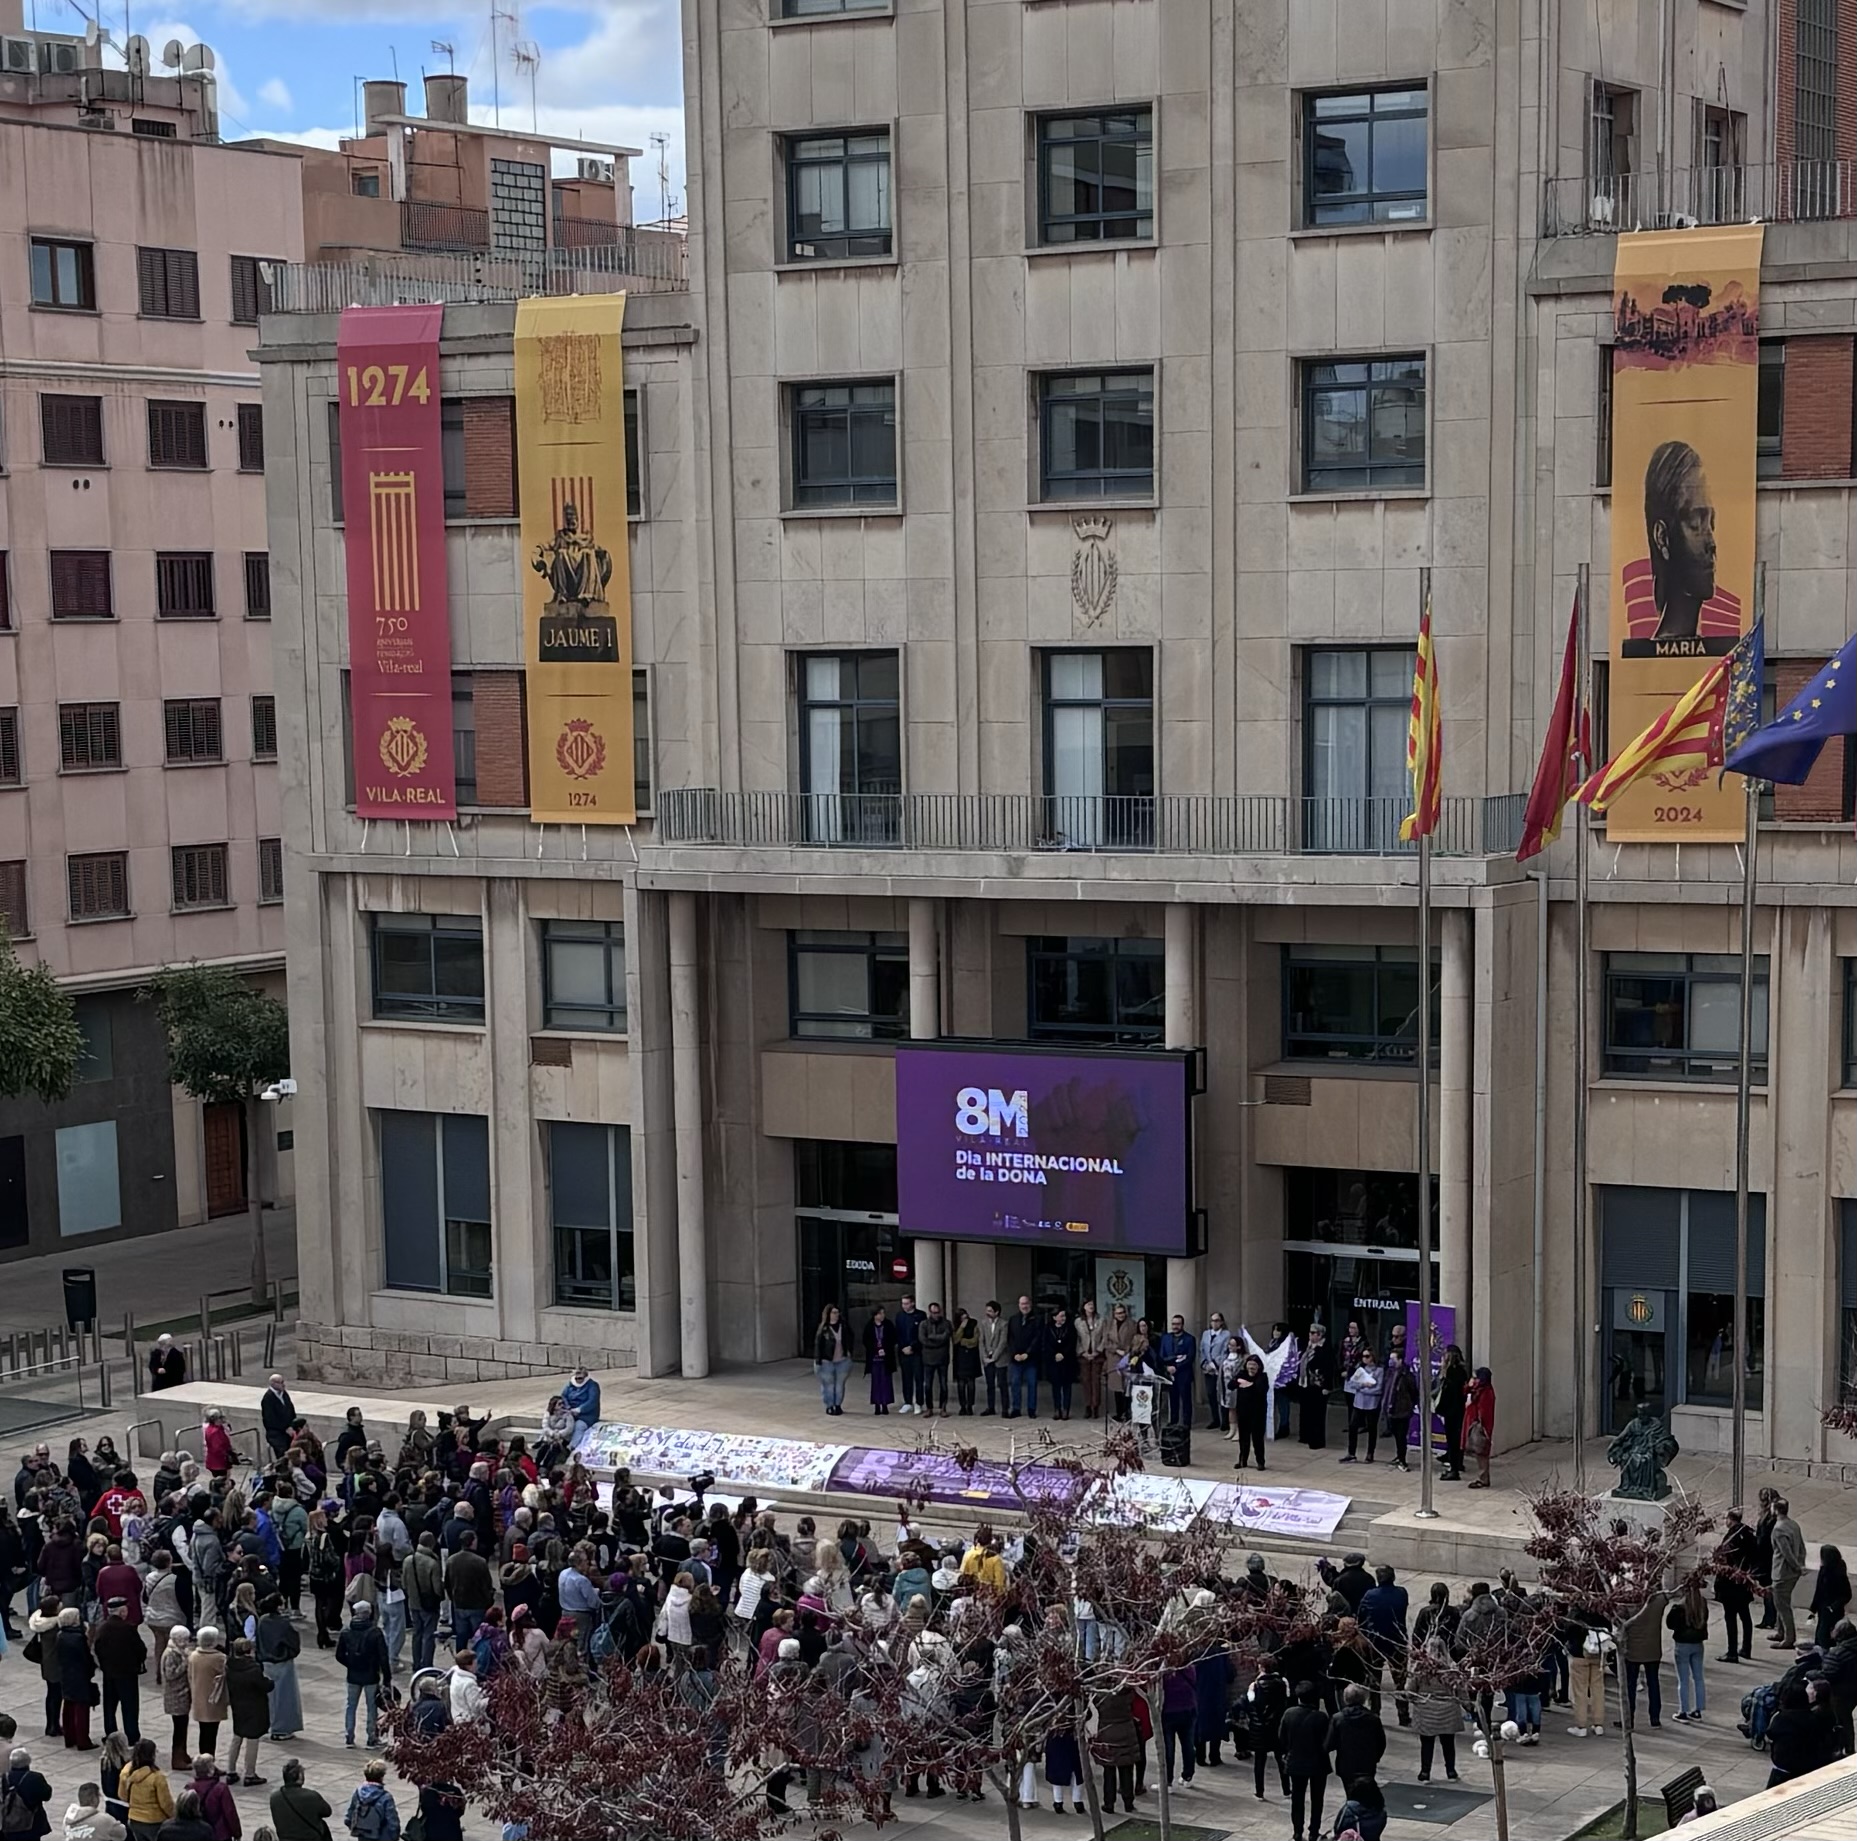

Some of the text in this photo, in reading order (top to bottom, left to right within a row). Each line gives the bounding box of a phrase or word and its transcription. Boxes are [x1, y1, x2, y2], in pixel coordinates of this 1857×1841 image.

[348, 365, 431, 407] 1274
[376, 617, 408, 636] 750
[544, 628, 598, 648] JAUME
[568, 793, 597, 807] 1274
[1653, 807, 1703, 822] 2024
[955, 1087, 1028, 1138] 8M
[986, 1152, 1124, 1175] INTERNACIONAL
[956, 1166, 1047, 1185] de la DONA
[1353, 1297, 1400, 1310] ENTRADA
